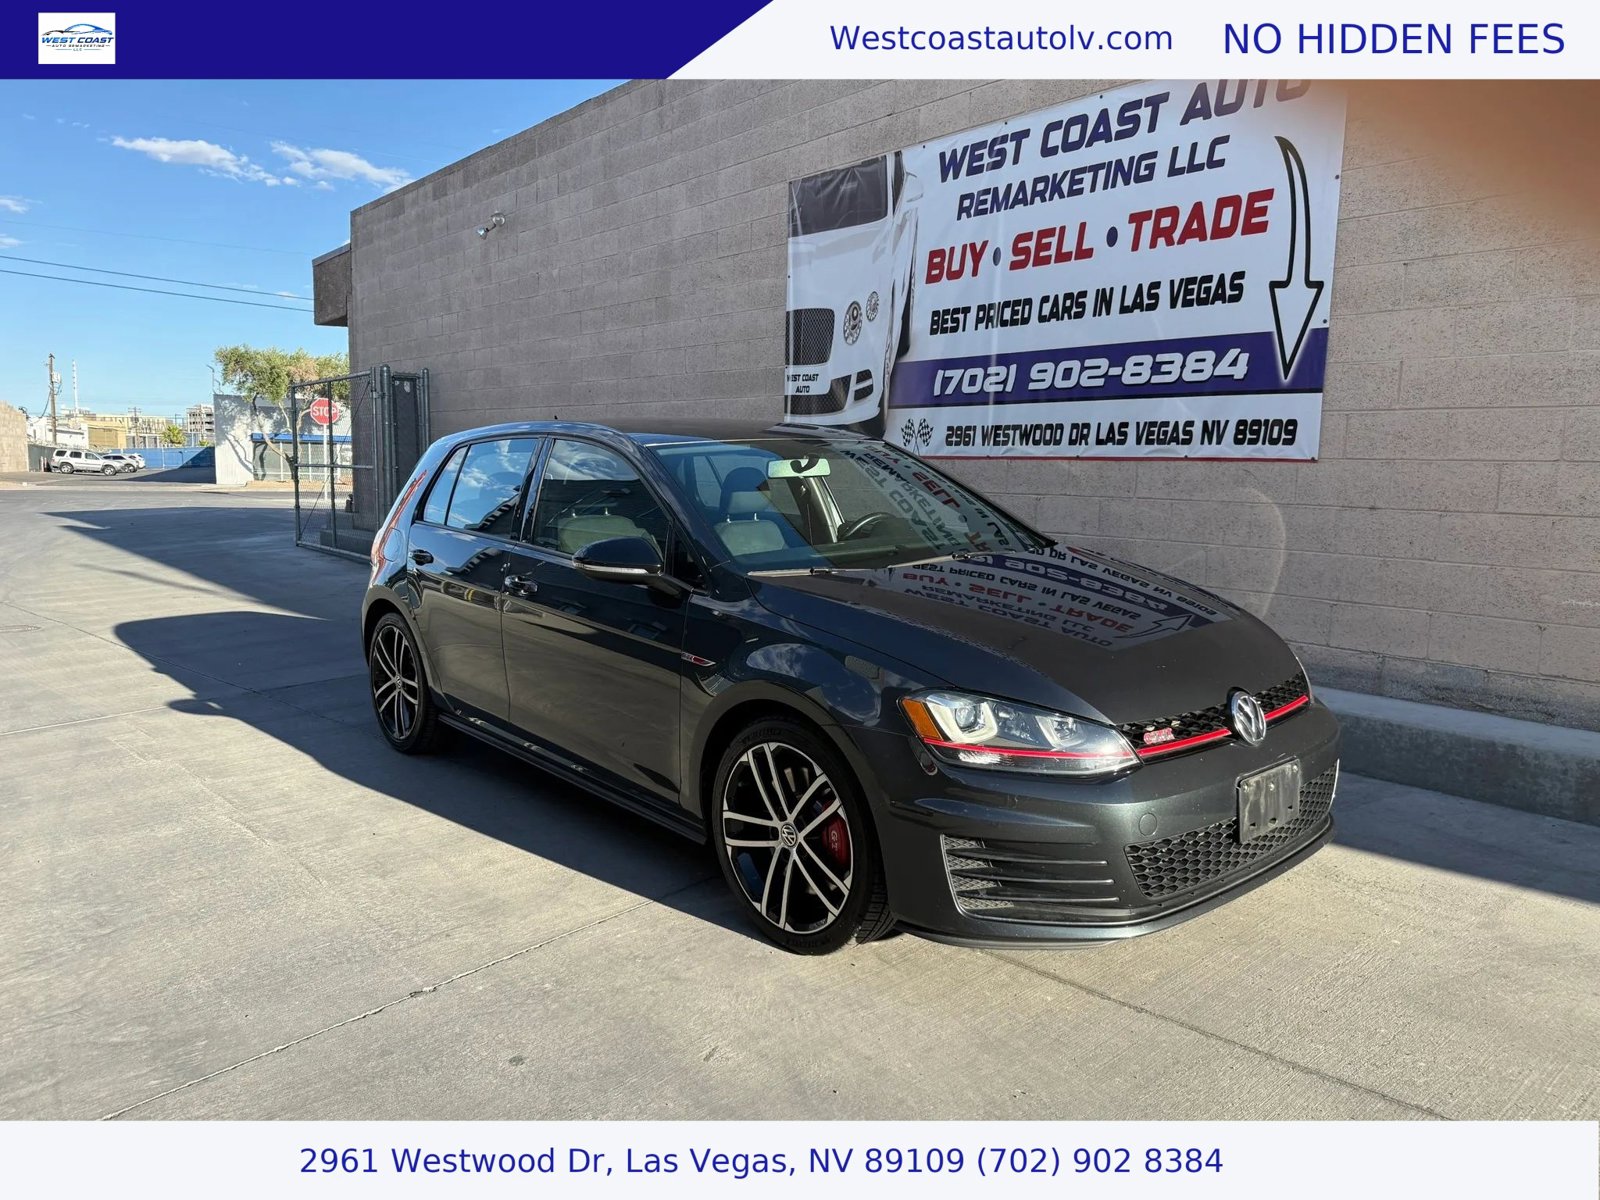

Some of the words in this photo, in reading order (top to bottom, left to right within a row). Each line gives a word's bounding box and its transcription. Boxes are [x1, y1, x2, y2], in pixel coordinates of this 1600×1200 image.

[939, 128, 1031, 183] WEST
[1040, 91, 1170, 158] COAST
[956, 150, 1159, 221] REMARKETING
[1167, 134, 1231, 178] LLC
[925, 240, 989, 284] BUY
[1009, 221, 1094, 271] SELL
[1128, 188, 1275, 252] TRADE
[929, 305, 971, 336] BEST
[974, 297, 1033, 331] PRICED
[1037, 289, 1088, 324] CARS
[1092, 286, 1114, 318] IN
[1119, 280, 1162, 315] LAS
[1169, 270, 1246, 309] VEGAS
[795, 385, 810, 394] AUTO
[802, 373, 819, 381] COAST
[933, 363, 1017, 396] (702)
[1027, 348, 1250, 391] 902-8384
[945, 425, 977, 447] 2961
[981, 422, 1064, 447] WESTWOOD
[1068, 422, 1091, 446] DR
[1095, 421, 1133, 445] LAS
[1135, 420, 1195, 446] VEGAS
[1200, 419, 1230, 446] NV
[1232, 418, 1298, 446] 89109
